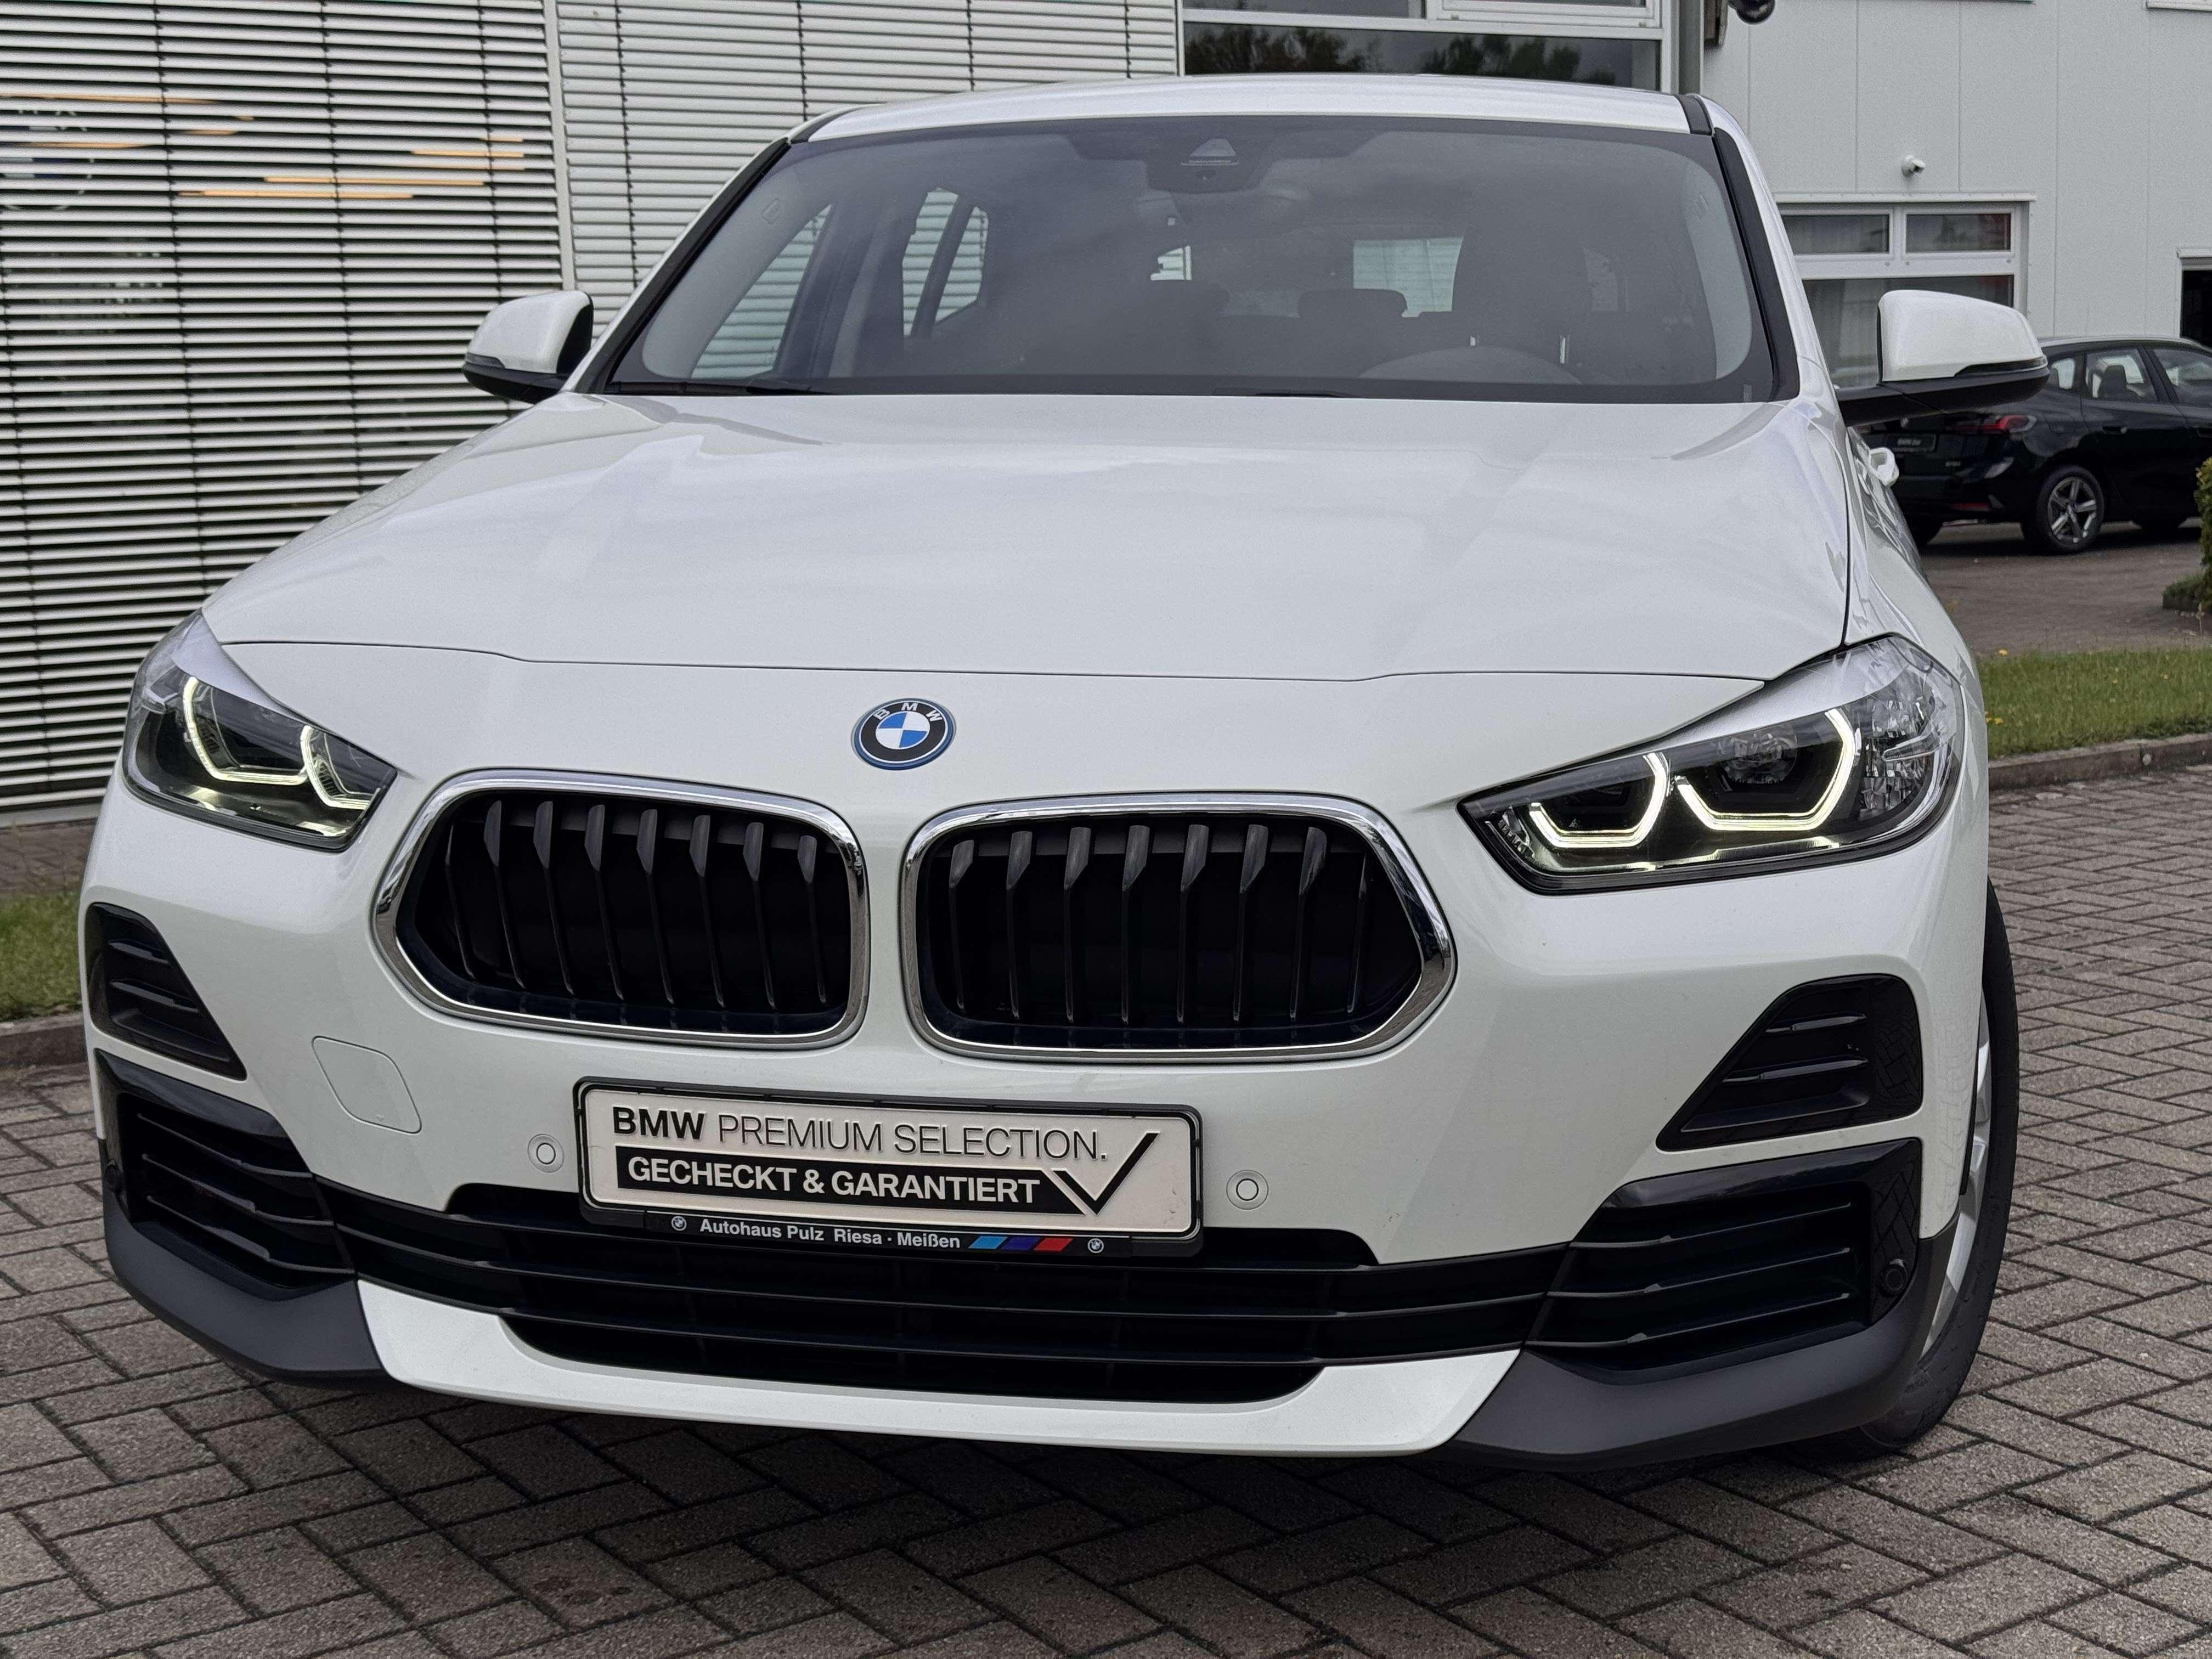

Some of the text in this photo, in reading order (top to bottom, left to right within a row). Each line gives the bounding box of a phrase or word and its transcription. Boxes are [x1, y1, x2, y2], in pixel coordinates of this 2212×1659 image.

[873, 702, 943, 722] BMW
[612, 1107, 1107, 1160] BMW PREMIUM SELECTION.
[628, 1156, 1040, 1204] GECHECKT & GARANTIERT
[700, 1219, 782, 1238] Autohaus
[787, 1225, 825, 1242] Pulz
[834, 1228, 883, 1245] Riesa
[897, 1232, 961, 1249] Meißen
